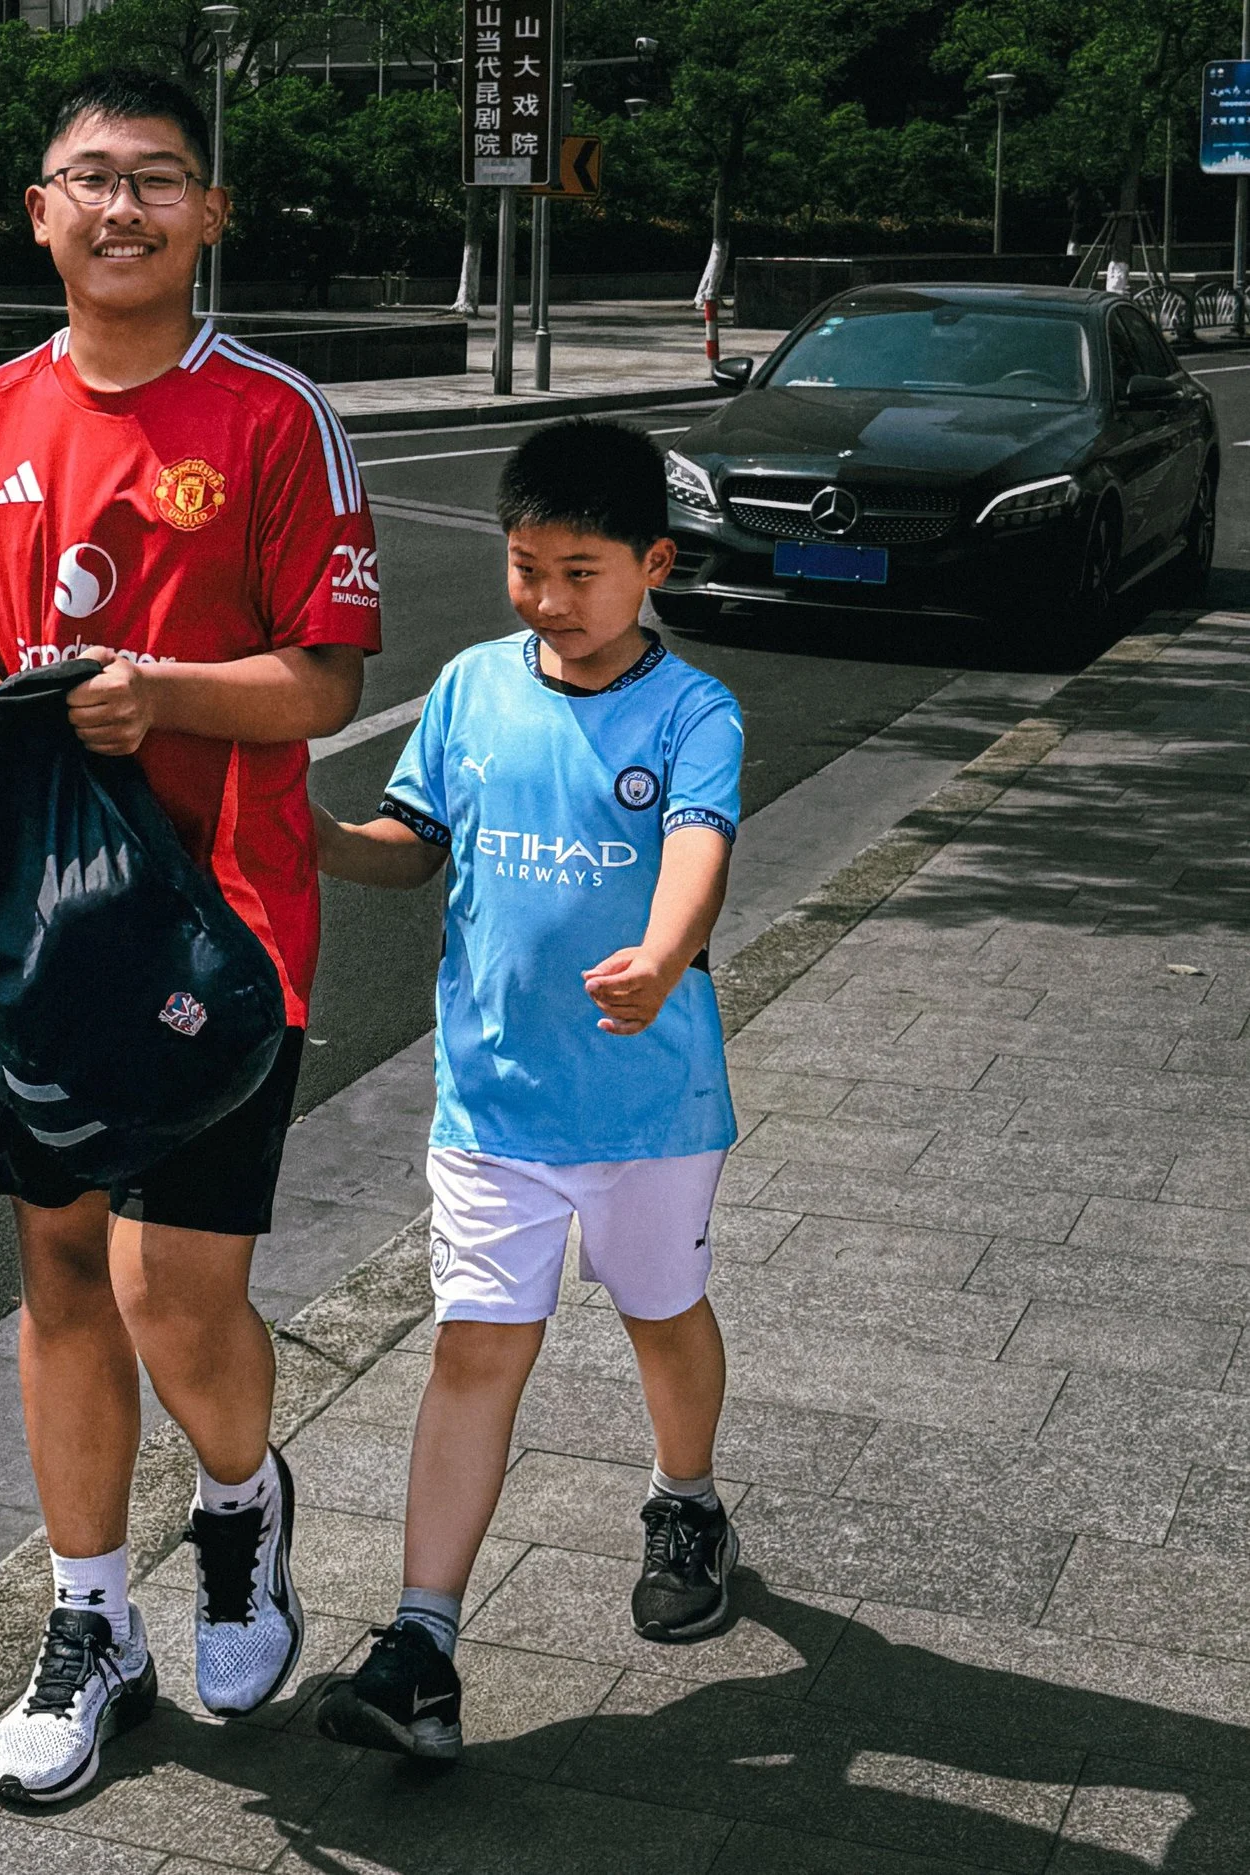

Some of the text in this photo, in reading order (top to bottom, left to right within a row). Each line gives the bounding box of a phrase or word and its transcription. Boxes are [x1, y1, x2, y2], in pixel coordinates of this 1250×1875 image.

[474, 0, 500, 156] 山当代昆剧院
[511, 16, 541, 156] 山大戏院
[168, 507, 208, 523] UNITED
[476, 827, 638, 868] ETIHAD
[495, 862, 603, 888] AIRWAYS
